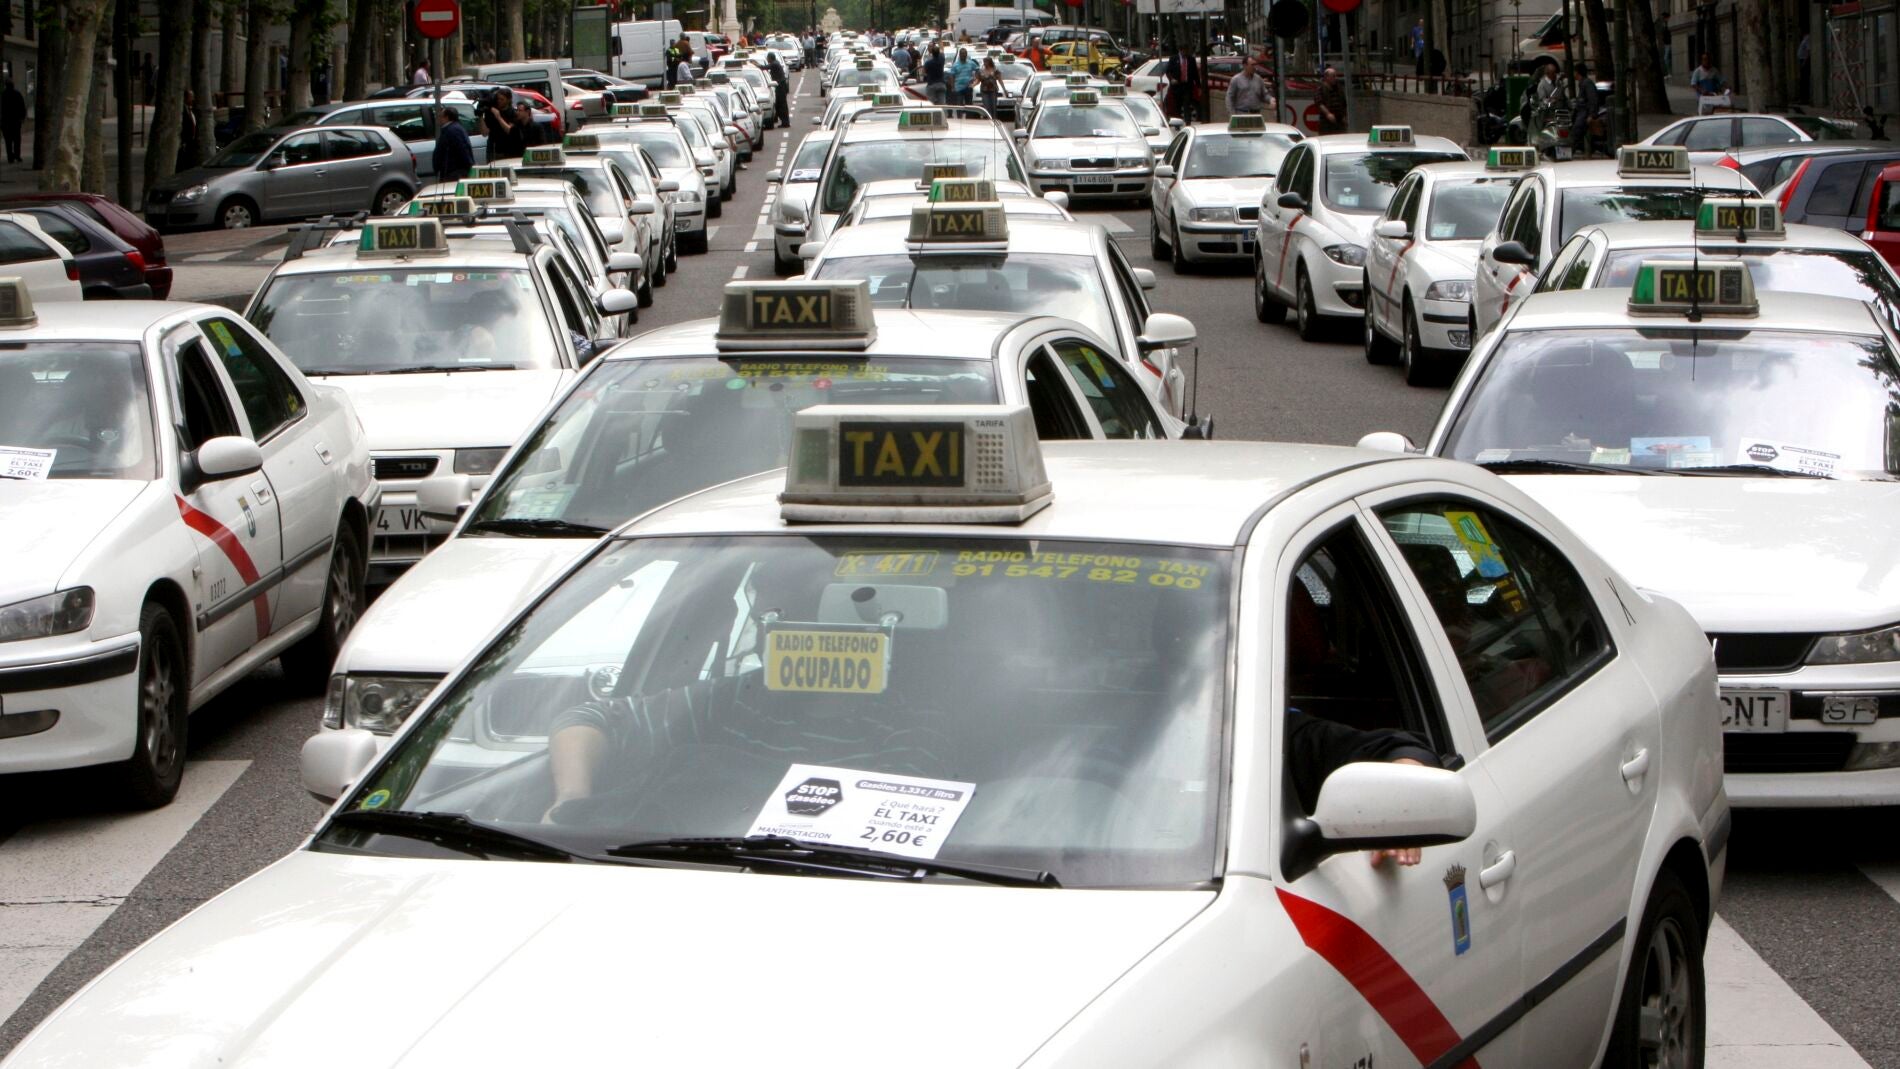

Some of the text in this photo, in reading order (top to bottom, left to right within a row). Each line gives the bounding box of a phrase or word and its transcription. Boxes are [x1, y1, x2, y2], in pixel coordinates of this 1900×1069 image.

[911, 113, 931, 124] TAXI
[1381, 130, 1401, 142] TAXI
[532, 150, 550, 161] TAXI
[1501, 152, 1523, 165] TAXI
[1638, 153, 1673, 167] TAXI
[469, 184, 493, 197] TAXI
[945, 186, 974, 200] TAXI
[932, 214, 981, 232] TAXI
[379, 227, 416, 247] TAXI
[755, 296, 827, 323] TAXI
[844, 431, 959, 477] TAXI
[400, 508, 427, 530] VK
[958, 551, 1209, 577] RADIO TELEFONO TAXI
[952, 564, 1201, 589] 91 547 82 00
[775, 634, 879, 653] RADIO TELEFONO
[780, 655, 872, 689] OCUPADO
[797, 784, 839, 796] STOP
[873, 807, 940, 825] EL TAXI
[757, 826, 832, 839] MANIFESTACION
[859, 826, 928, 847] 2,60€
